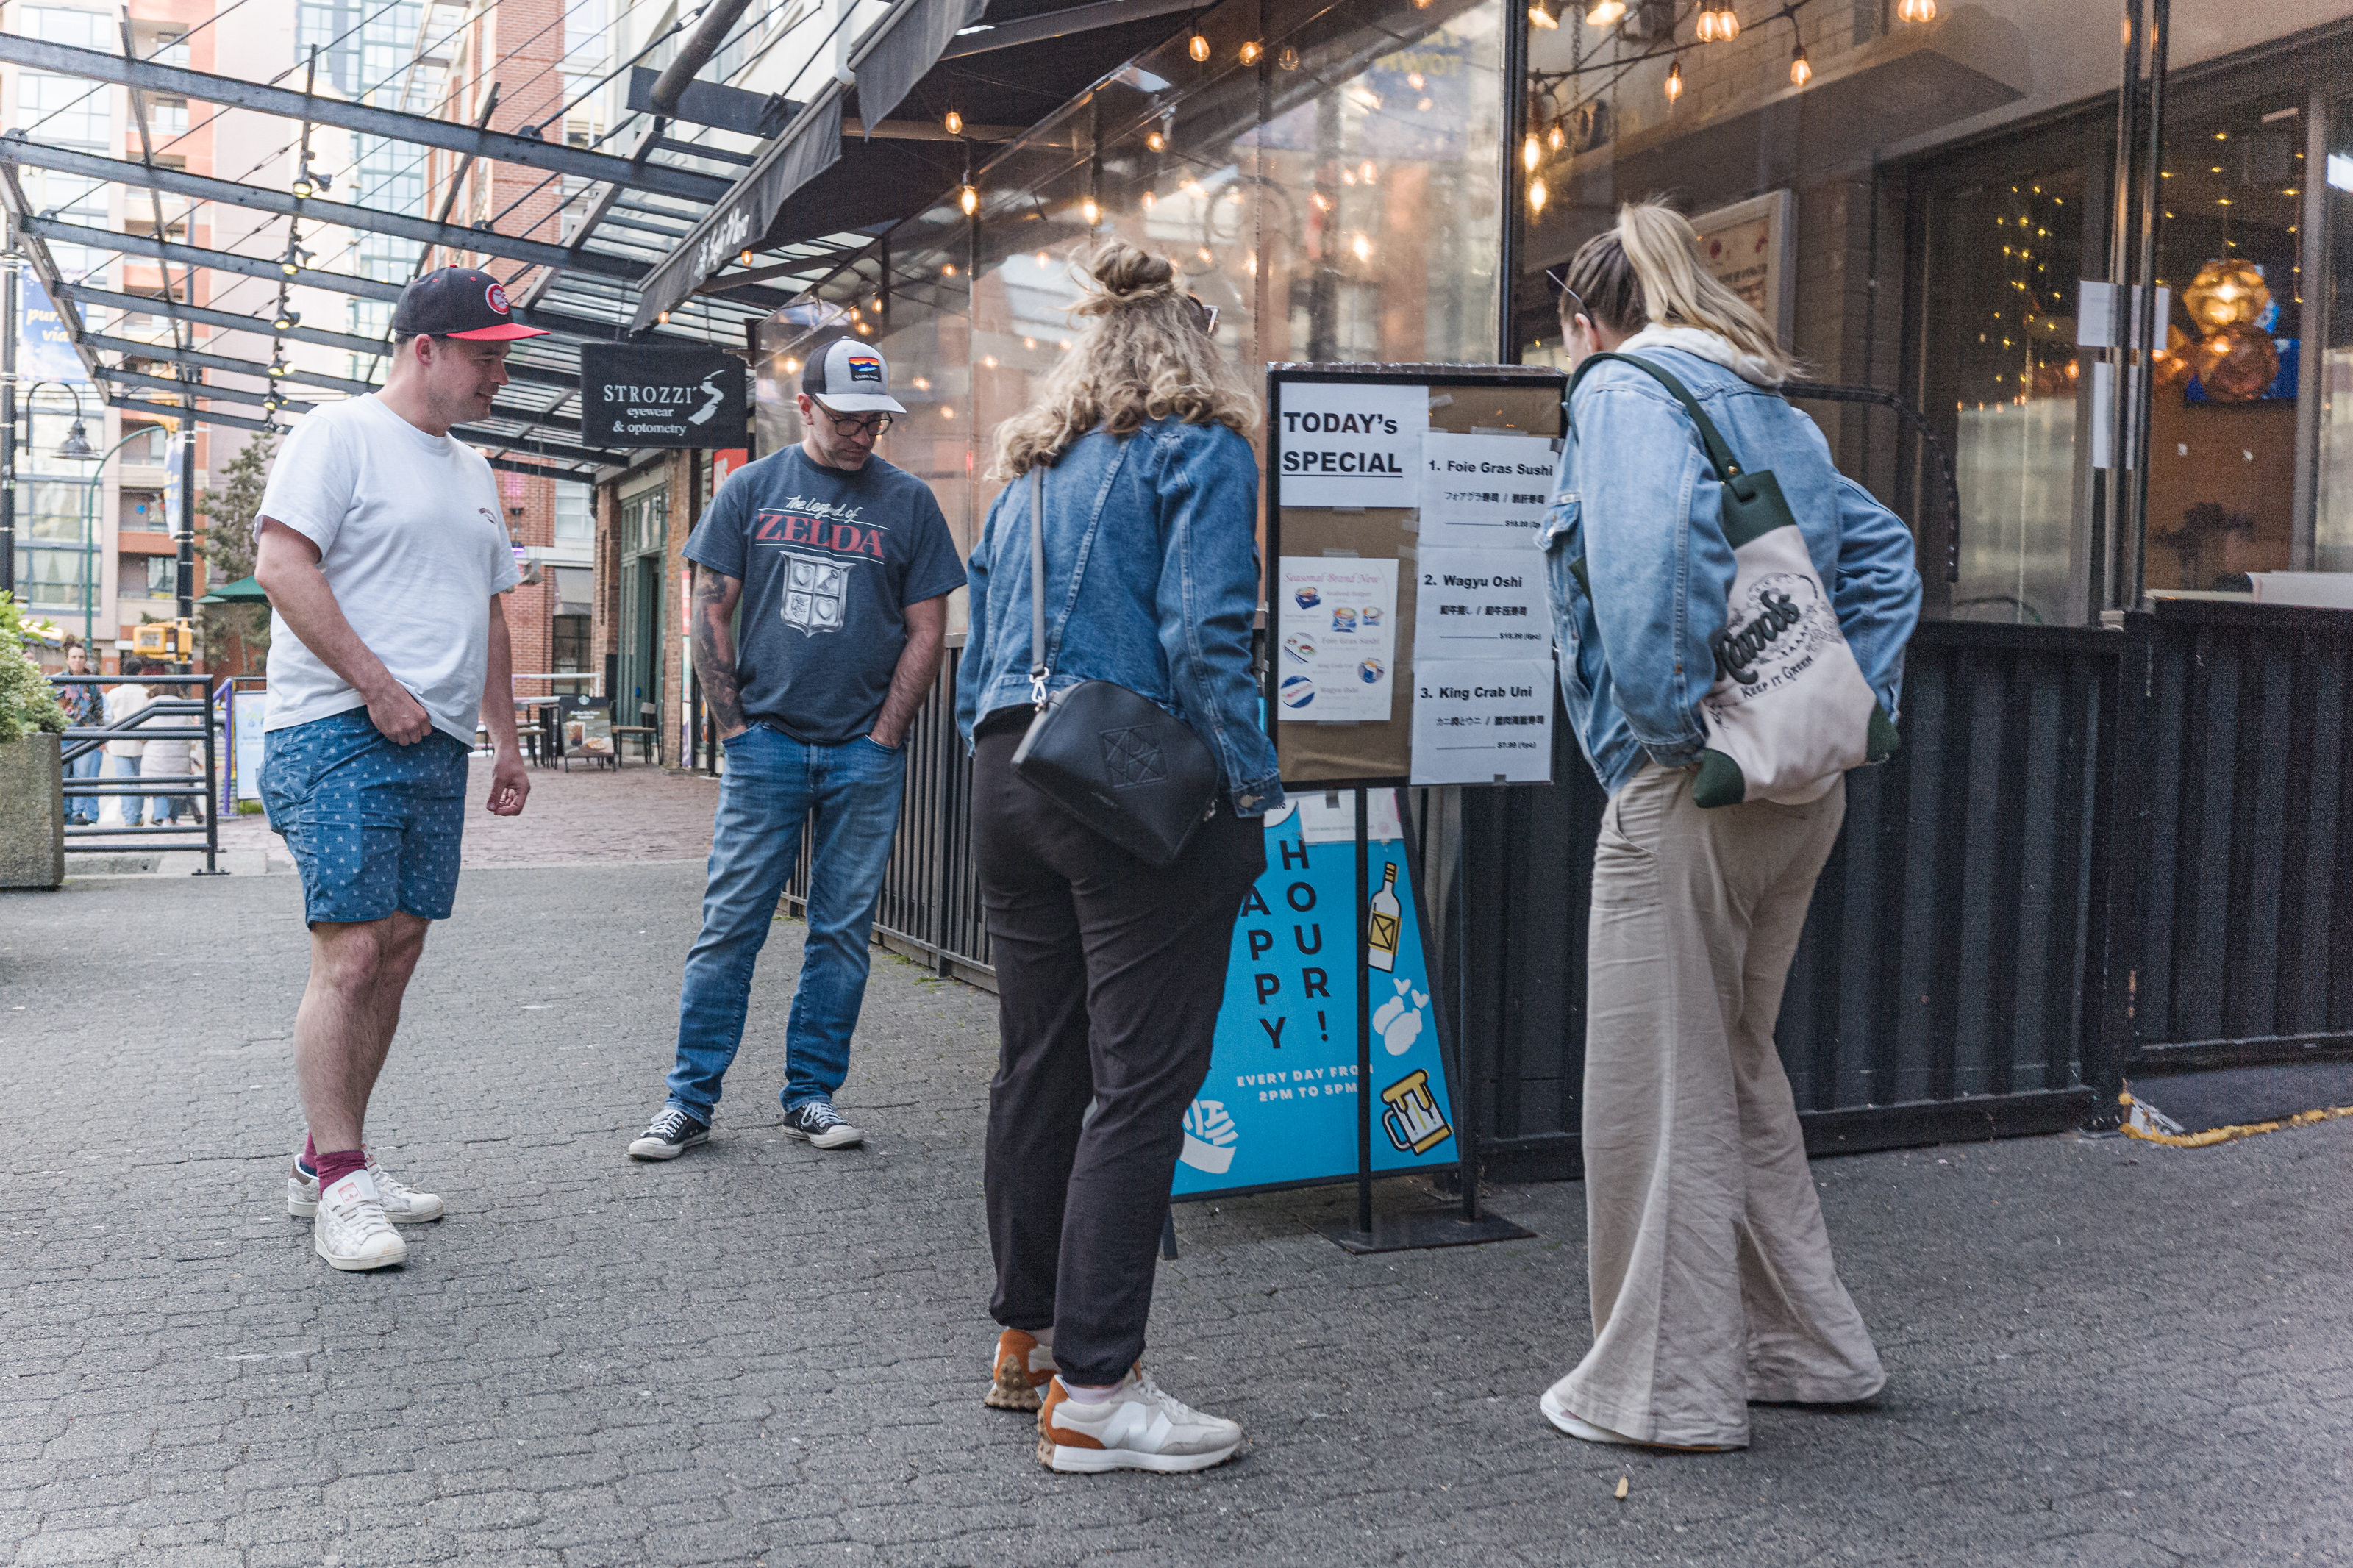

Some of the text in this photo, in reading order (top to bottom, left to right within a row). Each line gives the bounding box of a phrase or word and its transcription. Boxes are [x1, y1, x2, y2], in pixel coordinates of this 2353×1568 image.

[626, 407, 674, 418] eyewear
[1283, 412, 1398, 434] TODAY's
[613, 420, 687, 436] & optometry
[1283, 451, 1402, 473] SPECIAL
[1429, 459, 1553, 476] 1. Foie Gras Sushi
[786, 495, 807, 509] The
[845, 506, 863, 523] of
[756, 513, 885, 559] ZELDA
[1424, 574, 1522, 589] 2. Wagyu Oshi
[1420, 686, 1532, 700] 3. King Crab Uni
[1240, 884, 1287, 1049] APPY
[1236, 1063, 1374, 1087] EVERY DAY FRO
[1259, 1082, 1358, 1102] 2PM TO 5PM
